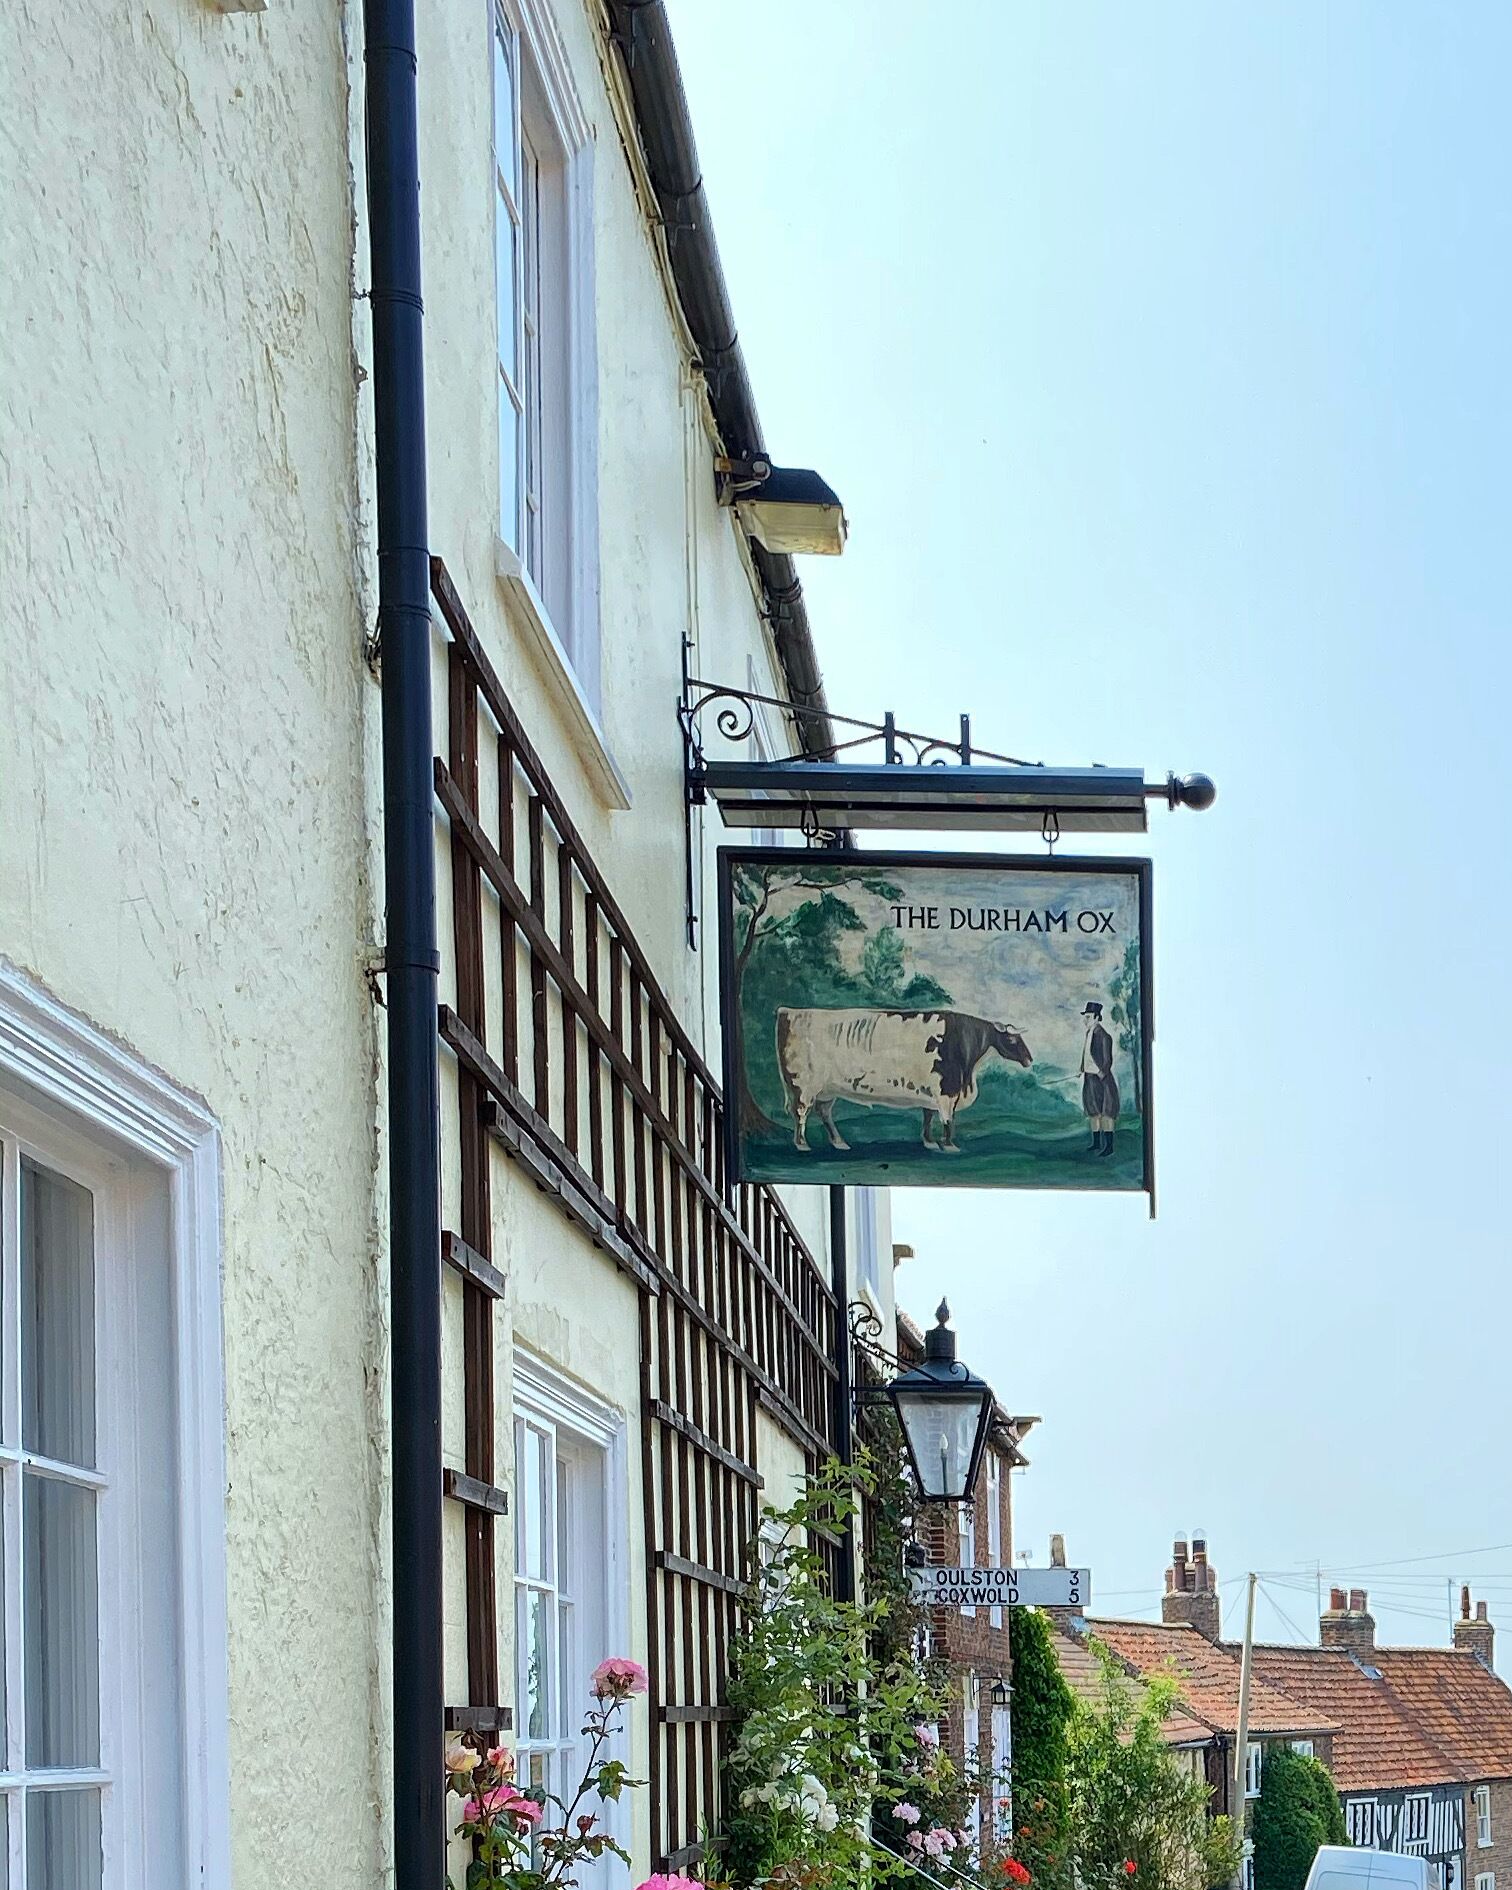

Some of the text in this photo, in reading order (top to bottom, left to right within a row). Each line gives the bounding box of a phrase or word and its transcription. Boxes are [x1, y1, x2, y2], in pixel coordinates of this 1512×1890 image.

[890, 906, 1116, 933] THE DURHAM OX
[936, 1570, 1079, 1586] OULSTON 3
[937, 1588, 1080, 1604] COXWOLD 5
